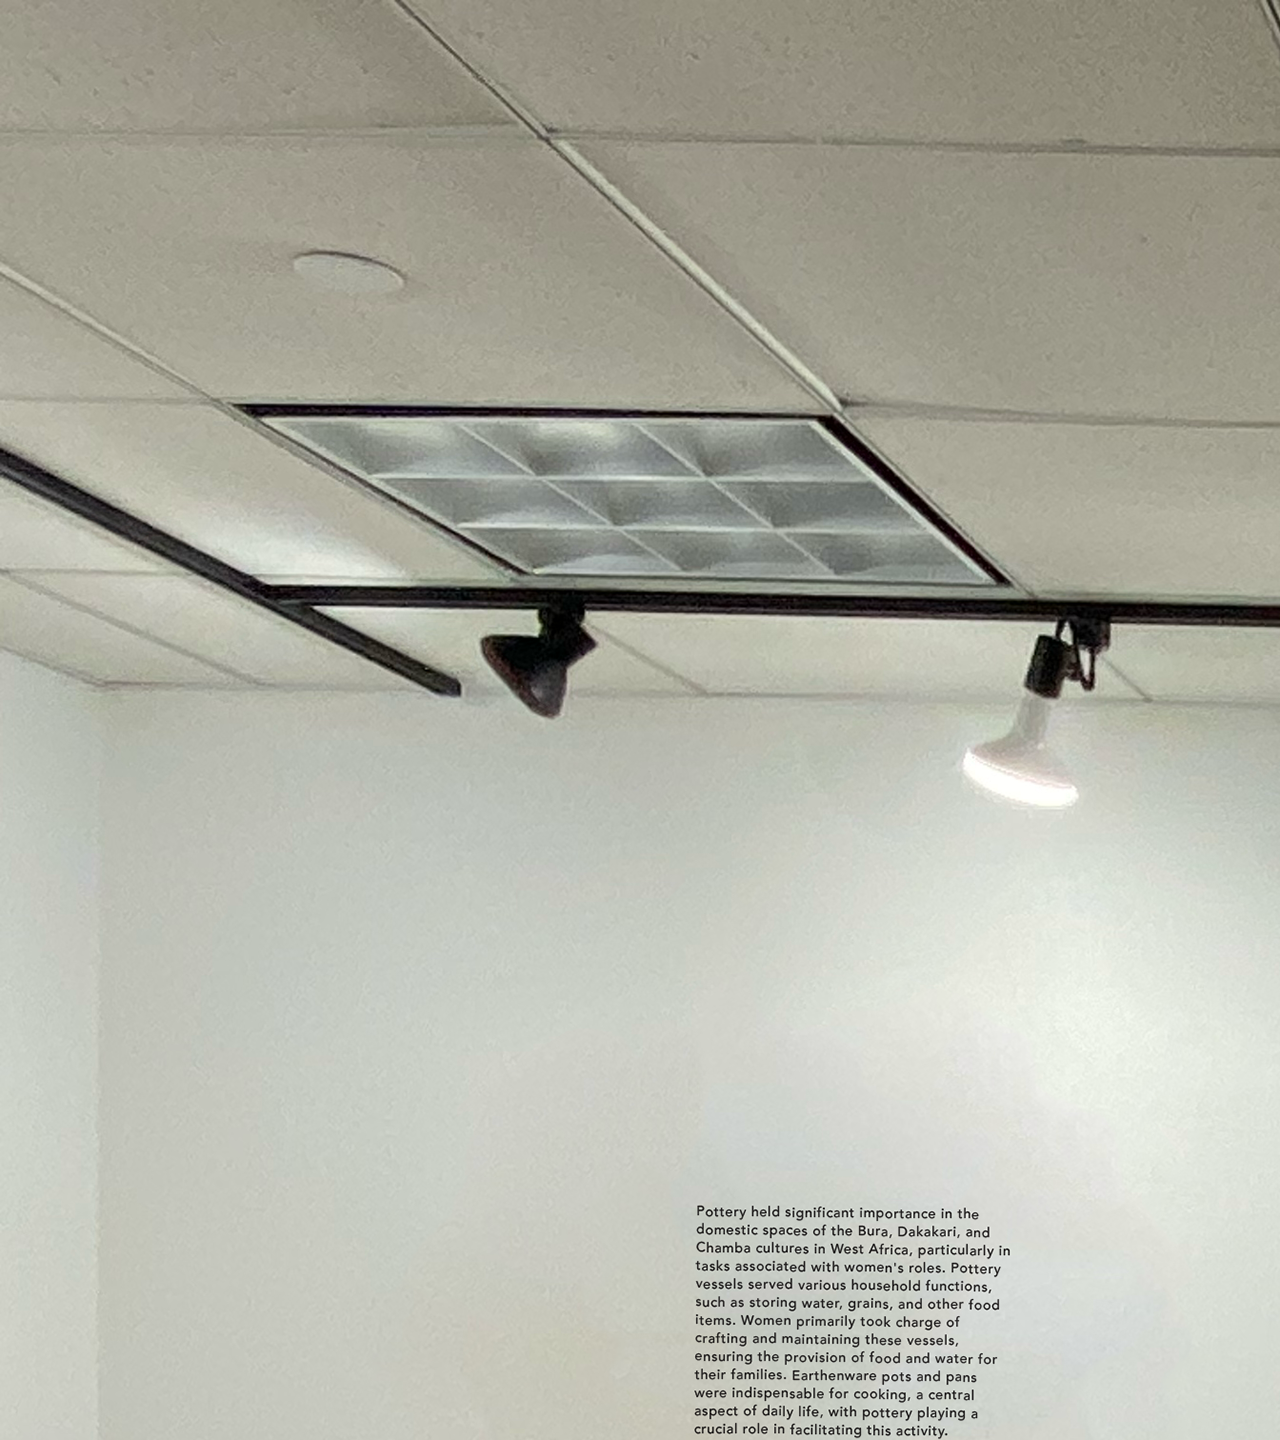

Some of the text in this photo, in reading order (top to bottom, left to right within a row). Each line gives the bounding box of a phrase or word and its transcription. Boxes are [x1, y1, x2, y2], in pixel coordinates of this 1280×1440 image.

[696, 1204, 980, 1222] Pottery held significant importance in the
[695, 1259, 1002, 1278] tasks associated with women's roles. Pottery
